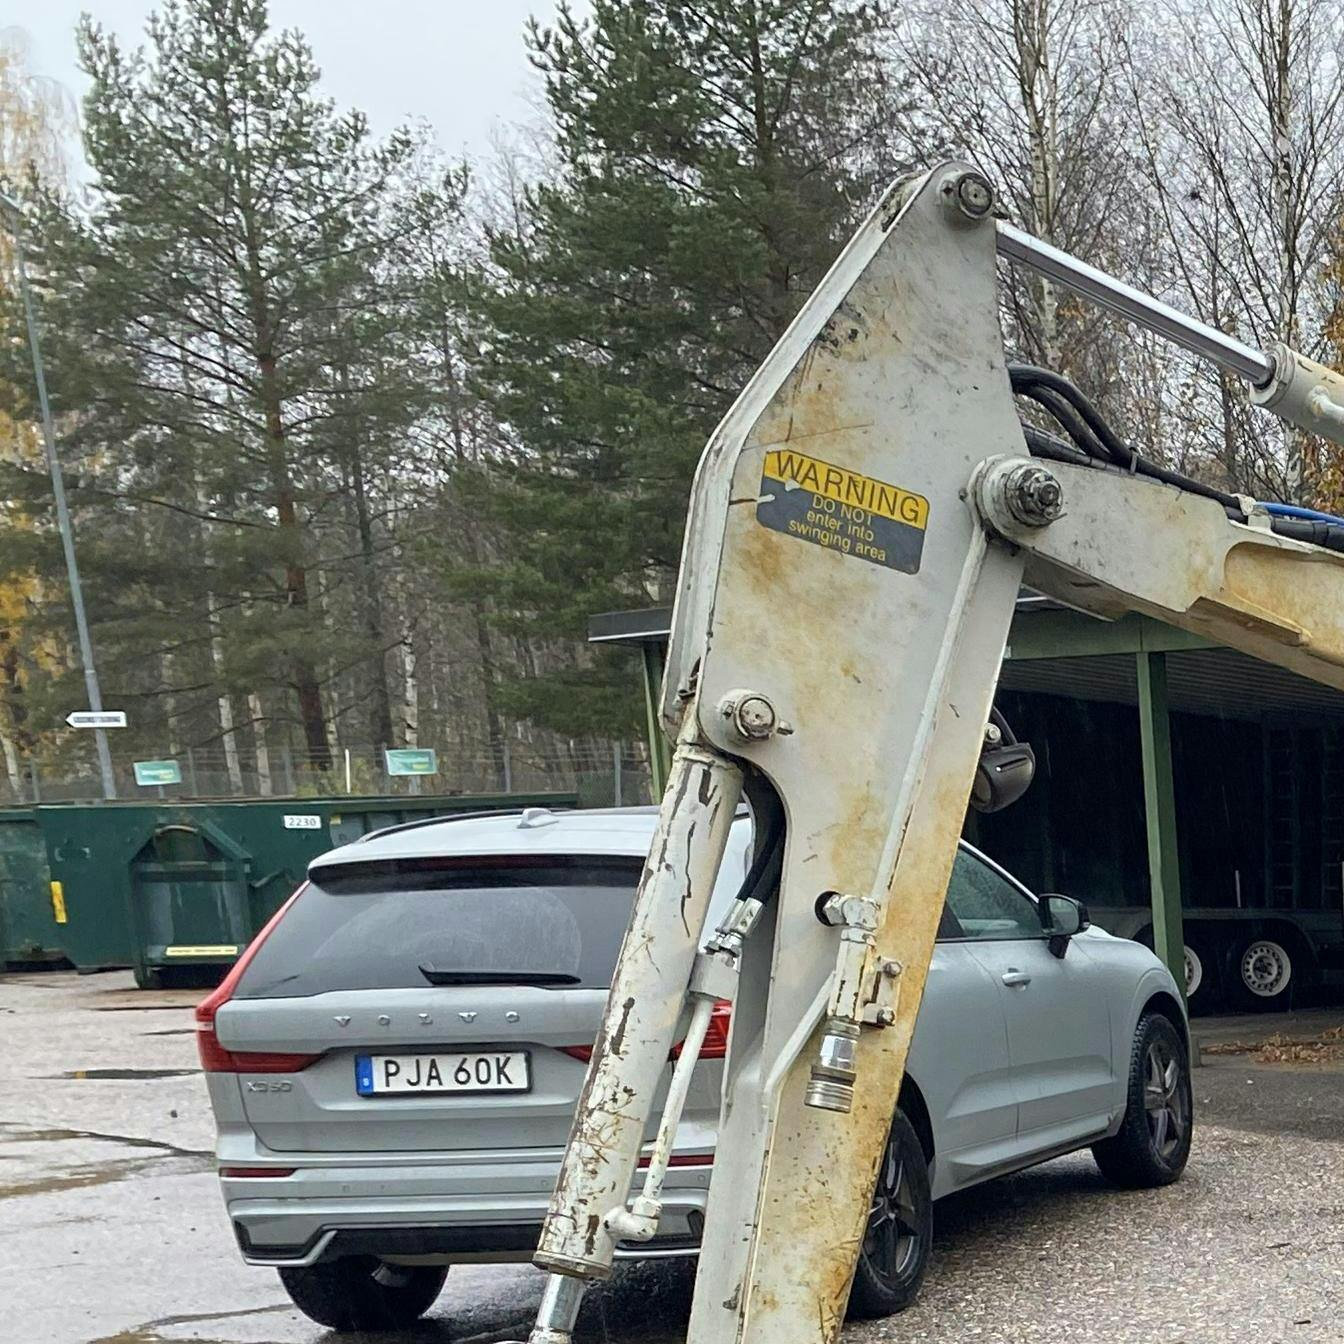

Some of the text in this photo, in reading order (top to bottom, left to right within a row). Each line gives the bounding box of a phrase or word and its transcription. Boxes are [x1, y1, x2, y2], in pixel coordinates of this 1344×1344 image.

[776, 451, 919, 523] WARNING
[812, 494, 873, 525] DO NOT
[789, 519, 886, 561] swinging area
[806, 510, 874, 542] enter into
[288, 817, 316, 826] 2230
[334, 1010, 520, 1027] VOLVO
[385, 1056, 513, 1088] PJA 60K
